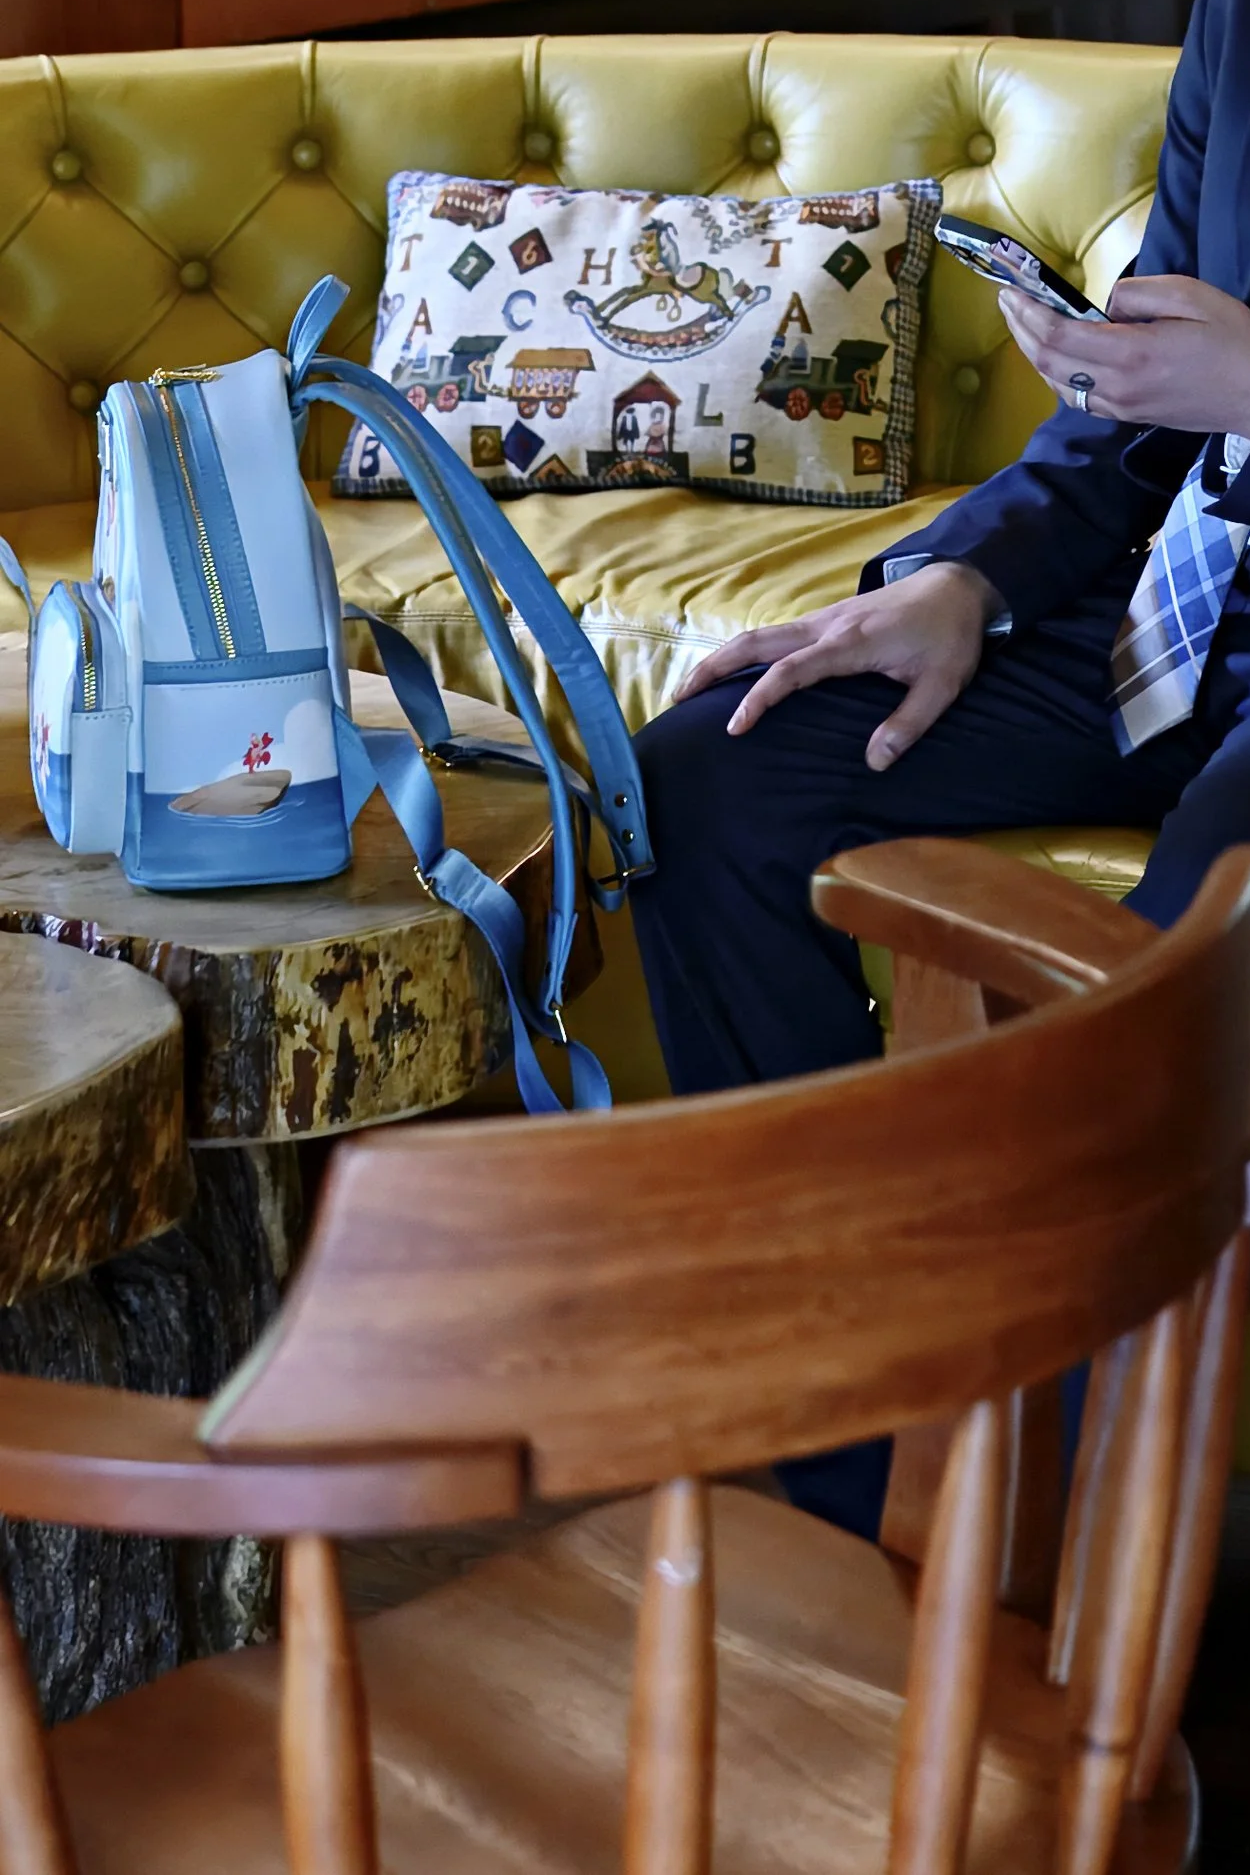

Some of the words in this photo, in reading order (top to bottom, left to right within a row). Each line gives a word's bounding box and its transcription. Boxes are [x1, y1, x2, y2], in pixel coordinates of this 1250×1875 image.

[400, 233, 423, 272] T
[522, 240, 538, 265] 6
[578, 247, 617, 285] H
[761, 237, 793, 267] T
[406, 297, 432, 342] A
[502, 289, 537, 332] C
[773, 291, 813, 338] A
[695, 383, 723, 426] L
[730, 433, 756, 475] B
[861, 444, 878, 465] 2
